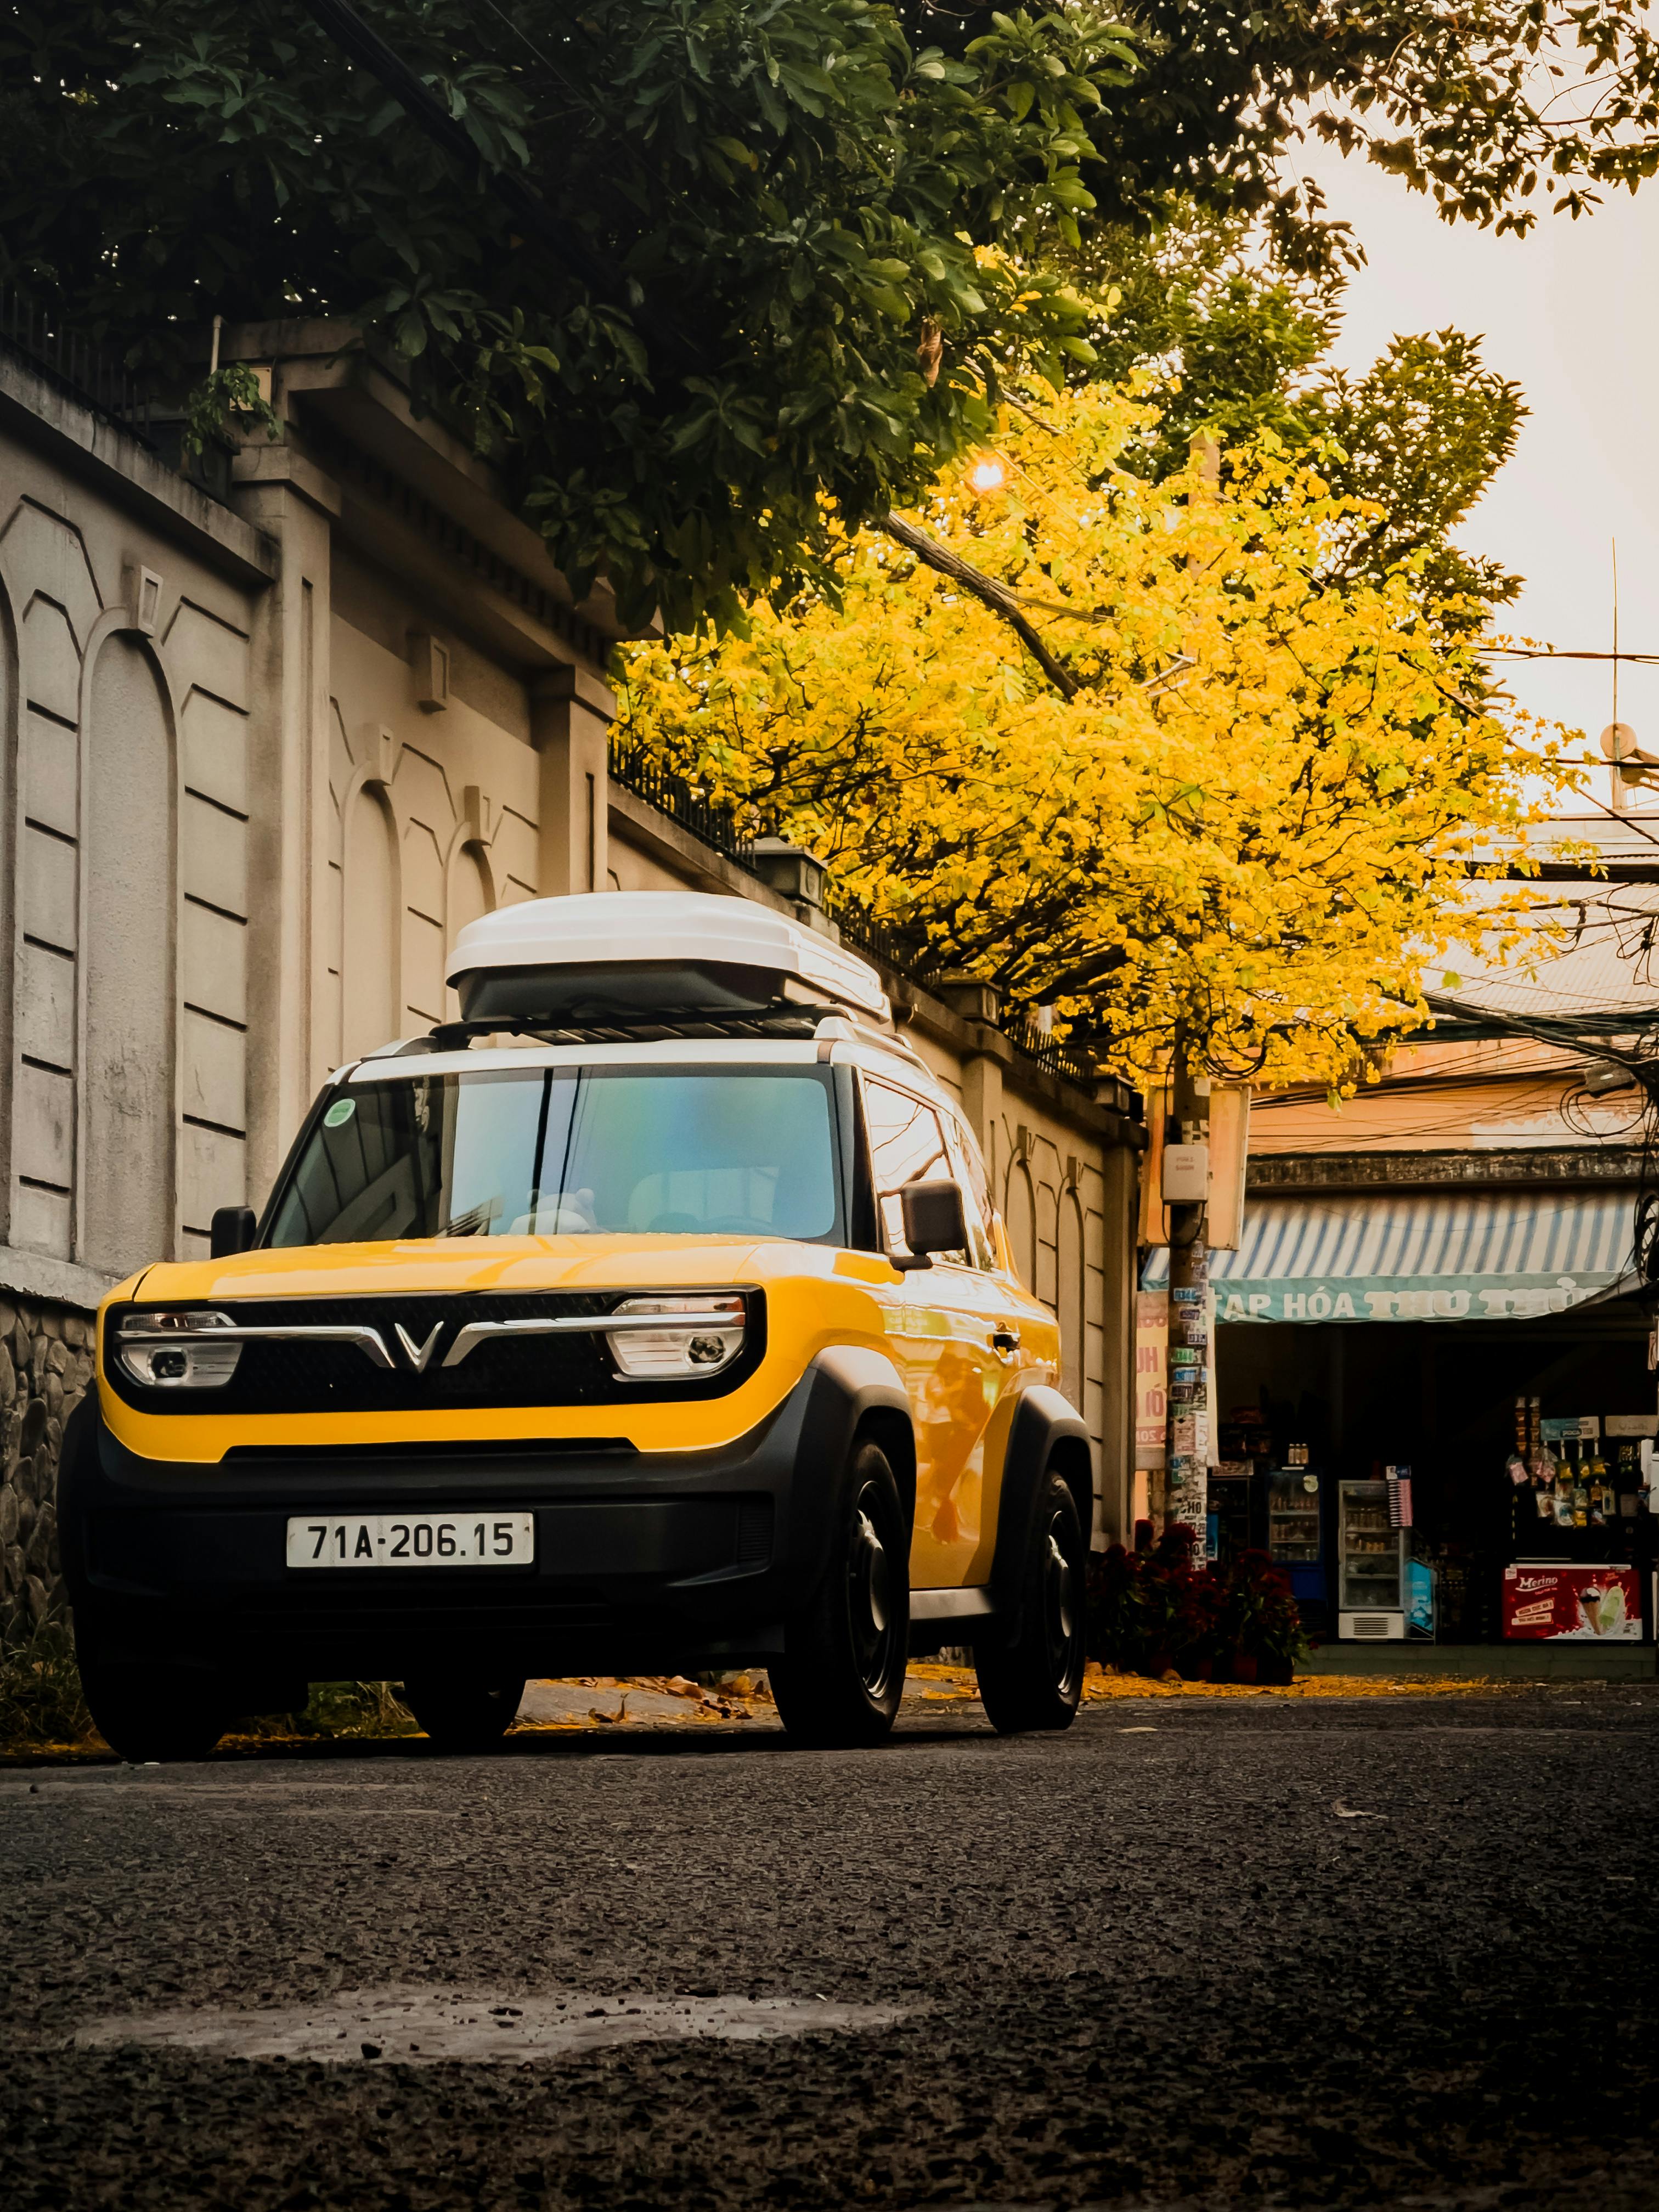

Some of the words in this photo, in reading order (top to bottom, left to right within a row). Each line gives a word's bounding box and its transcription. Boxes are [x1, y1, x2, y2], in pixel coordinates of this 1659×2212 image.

[1284, 1286, 1356, 1318] HÓA
[1364, 1290, 1472, 1317] THU
[1479, 1277, 1608, 1318] THỦ
[307, 1522, 513, 1559] 71A-206.15
[1519, 1575, 1558, 1589] Merino
